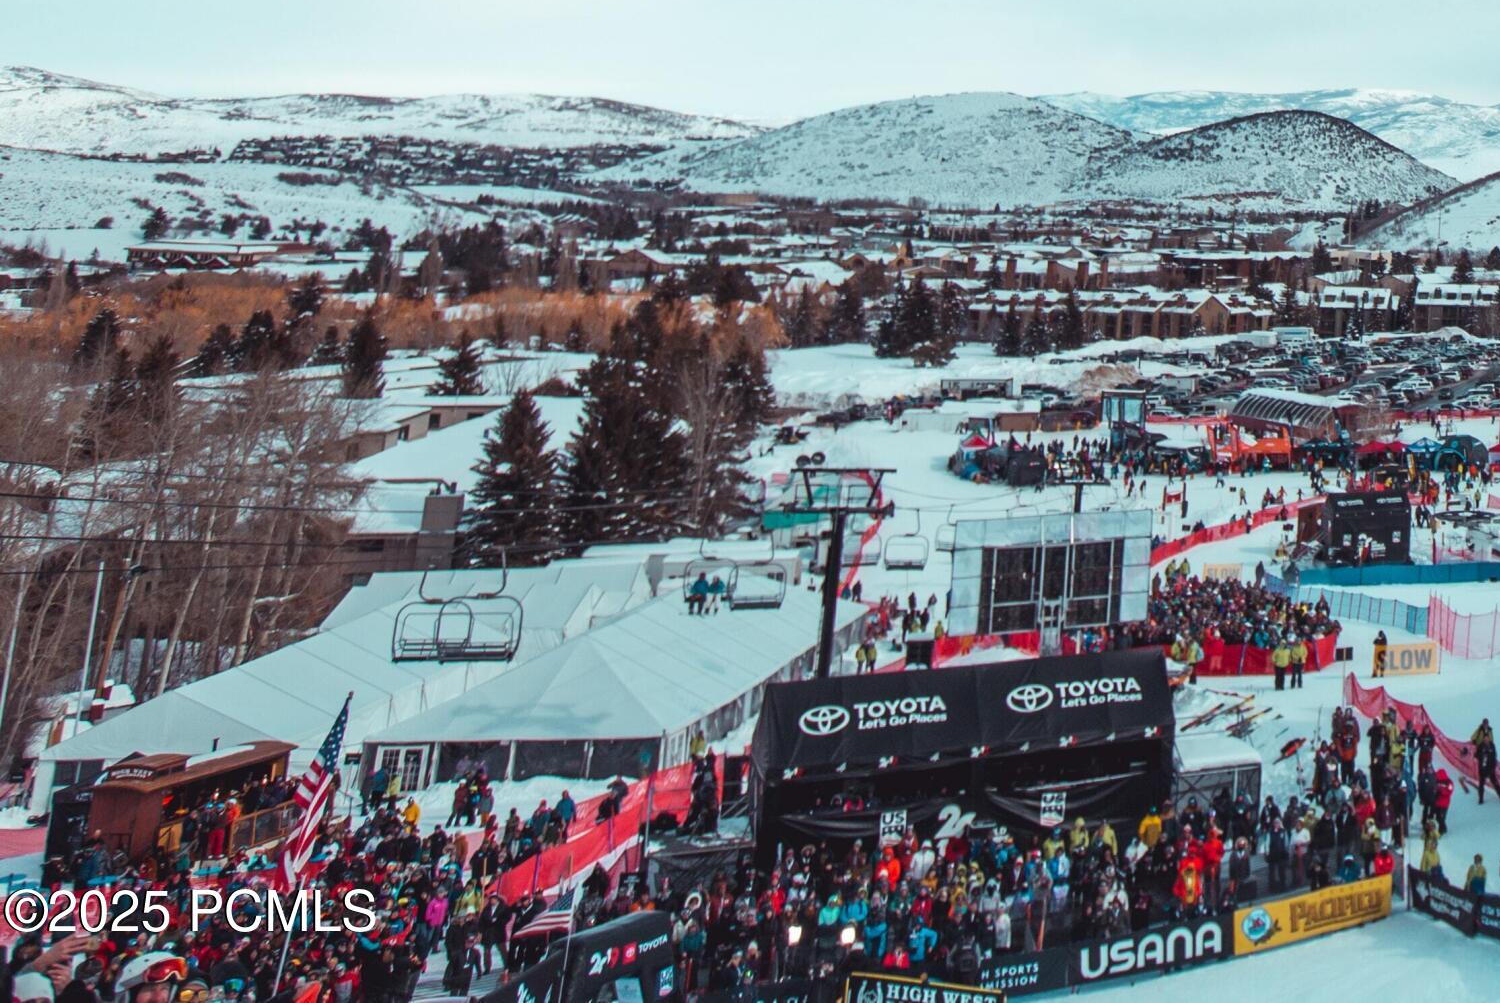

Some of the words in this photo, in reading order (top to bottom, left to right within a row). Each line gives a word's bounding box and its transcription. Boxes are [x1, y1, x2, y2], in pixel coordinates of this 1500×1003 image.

[1055, 677, 1142, 697] TOYOTA
[853, 695, 946, 719] TOYOTA
[1061, 696, 1087, 709] Let's
[1089, 694, 1106, 705] Go
[1107, 691, 1143, 703] Places
[858, 717, 887, 730] Let's
[889, 715, 907, 727] Go
[908, 711, 948, 725] Places
[882, 810, 906, 825] US
[638, 933, 668, 954] TOYOTA
[1080, 921, 1223, 980] USANA
[994, 961, 1040, 978] SPORTS
[885, 982, 937, 1002] HIGH
